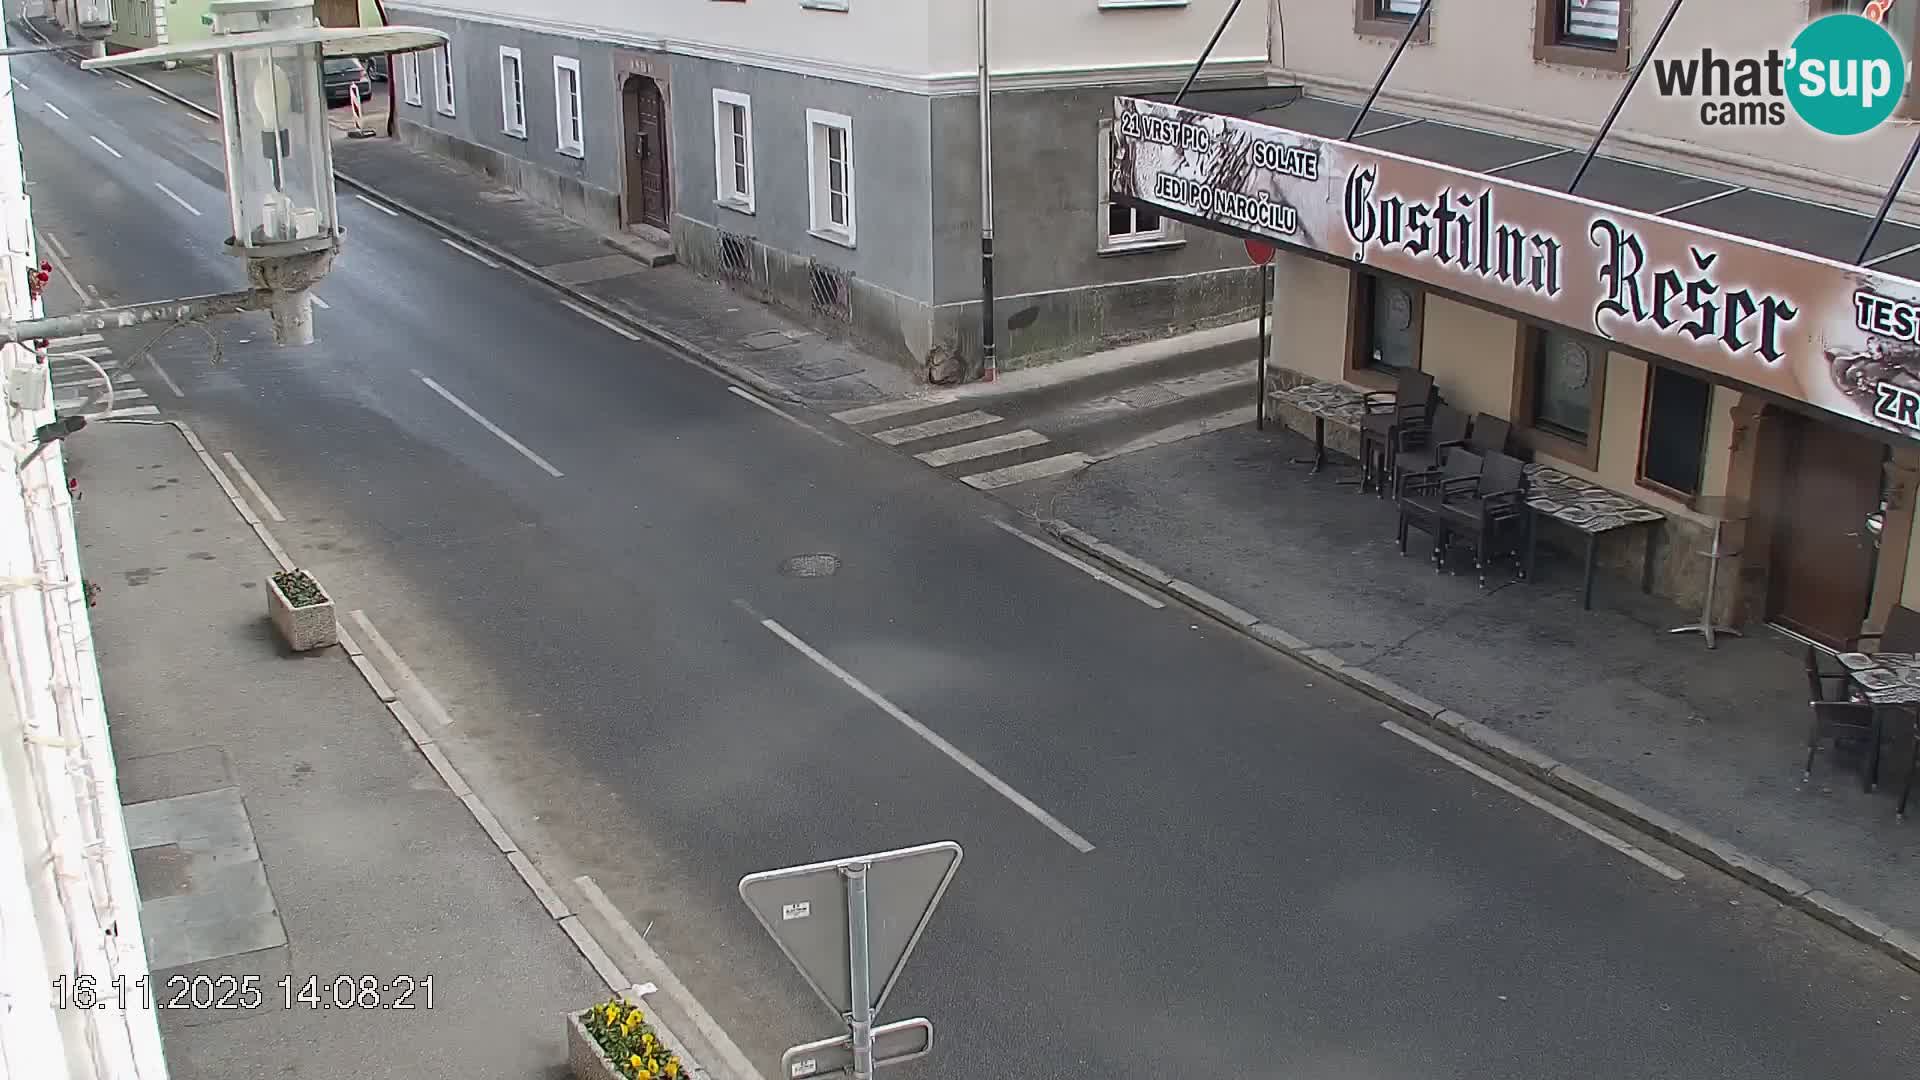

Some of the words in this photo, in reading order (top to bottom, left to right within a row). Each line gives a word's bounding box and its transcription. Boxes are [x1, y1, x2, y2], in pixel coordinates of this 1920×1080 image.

[1122, 112, 1140, 136] 21
[1143, 116, 1180, 145] VRST
[1182, 125, 1209, 152] PIC
[1253, 141, 1317, 178] SOLATE
[1156, 174, 1187, 203] JEDI
[1190, 183, 1212, 209] PO
[1214, 191, 1297, 233] NAROČILU
[1344, 163, 1562, 297] Gostilna
[1590, 218, 1799, 363] Rešer
